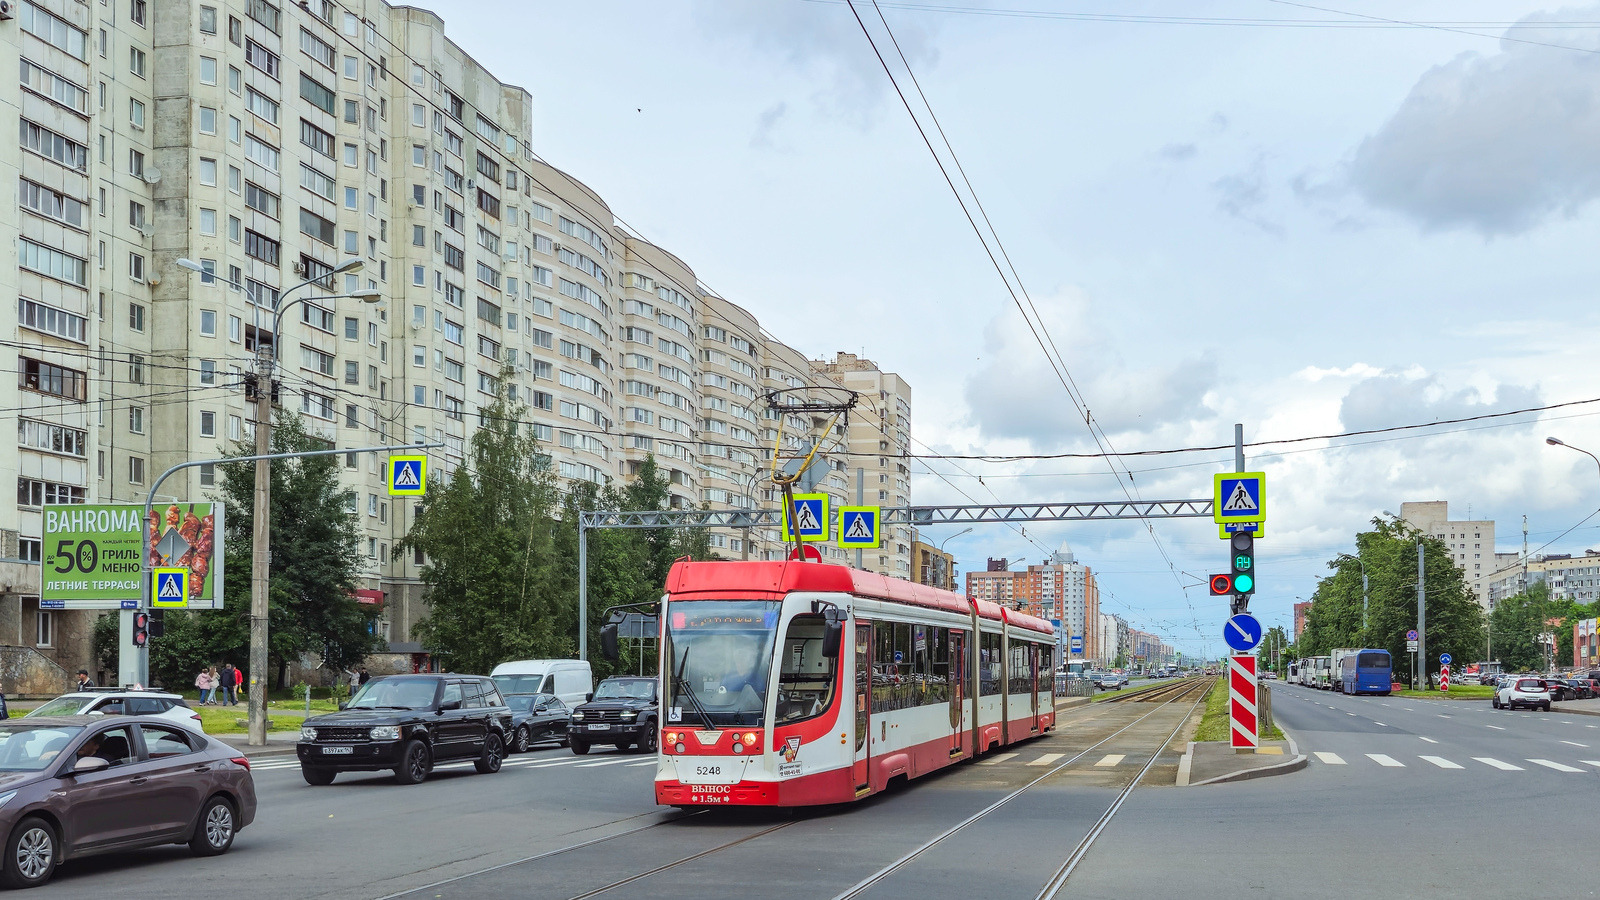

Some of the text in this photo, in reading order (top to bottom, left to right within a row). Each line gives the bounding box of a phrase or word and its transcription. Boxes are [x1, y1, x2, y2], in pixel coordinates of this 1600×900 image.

[46, 509, 141, 533] BAHROMA
[102, 549, 140, 559] ГРИЛЬ
[102, 563, 140, 573] МЕНЮ
[46, 580, 140, 590] ЛЕТНИЕ ТЕРРАСЫ
[696, 766, 721, 775] 5248
[691, 785, 731, 793] ВЫНОС
[700, 795, 721, 803] 1.5м
